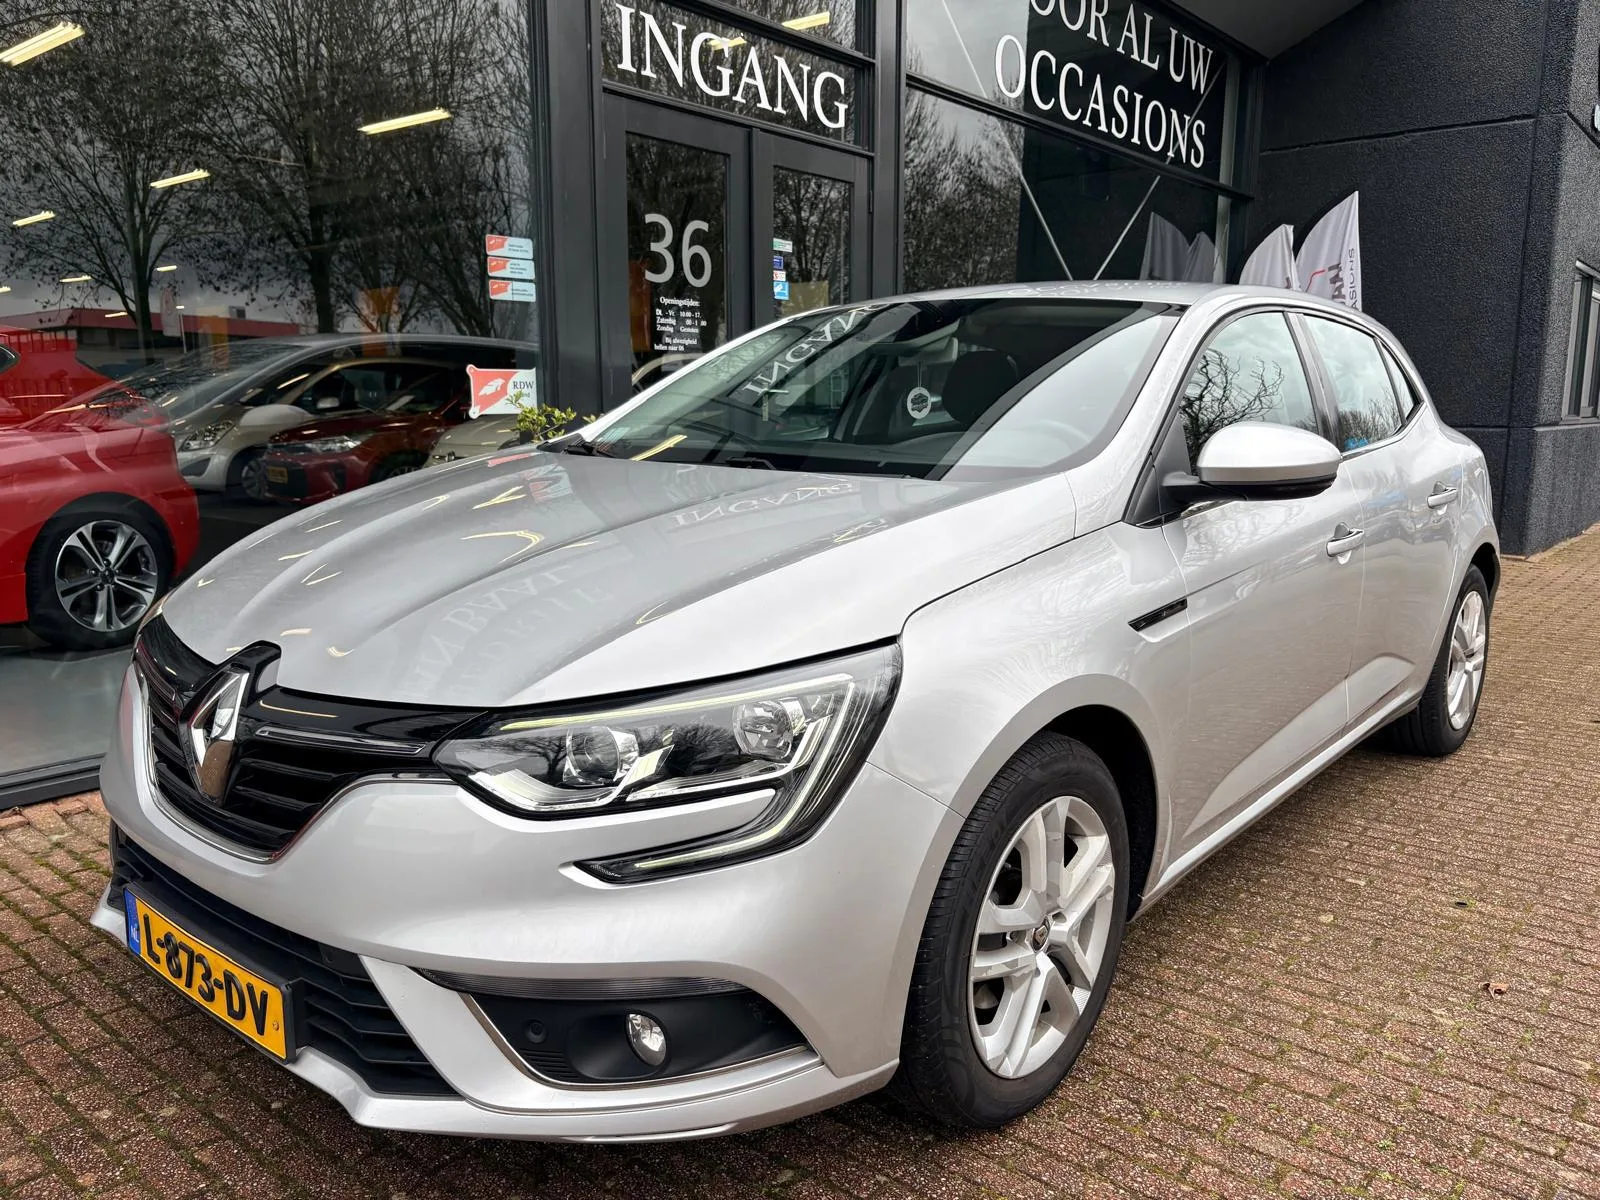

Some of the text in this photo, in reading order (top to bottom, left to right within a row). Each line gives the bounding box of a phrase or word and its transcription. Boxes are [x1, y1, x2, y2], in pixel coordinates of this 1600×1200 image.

[615, 3, 849, 129] INGANG
[995, 33, 1206, 169] OCCASIONS
[1030, 0, 1214, 96] OR AL UW
[643, 213, 712, 288] 36
[513, 380, 534, 390] RDW
[142, 912, 269, 1037] L-873-DV
